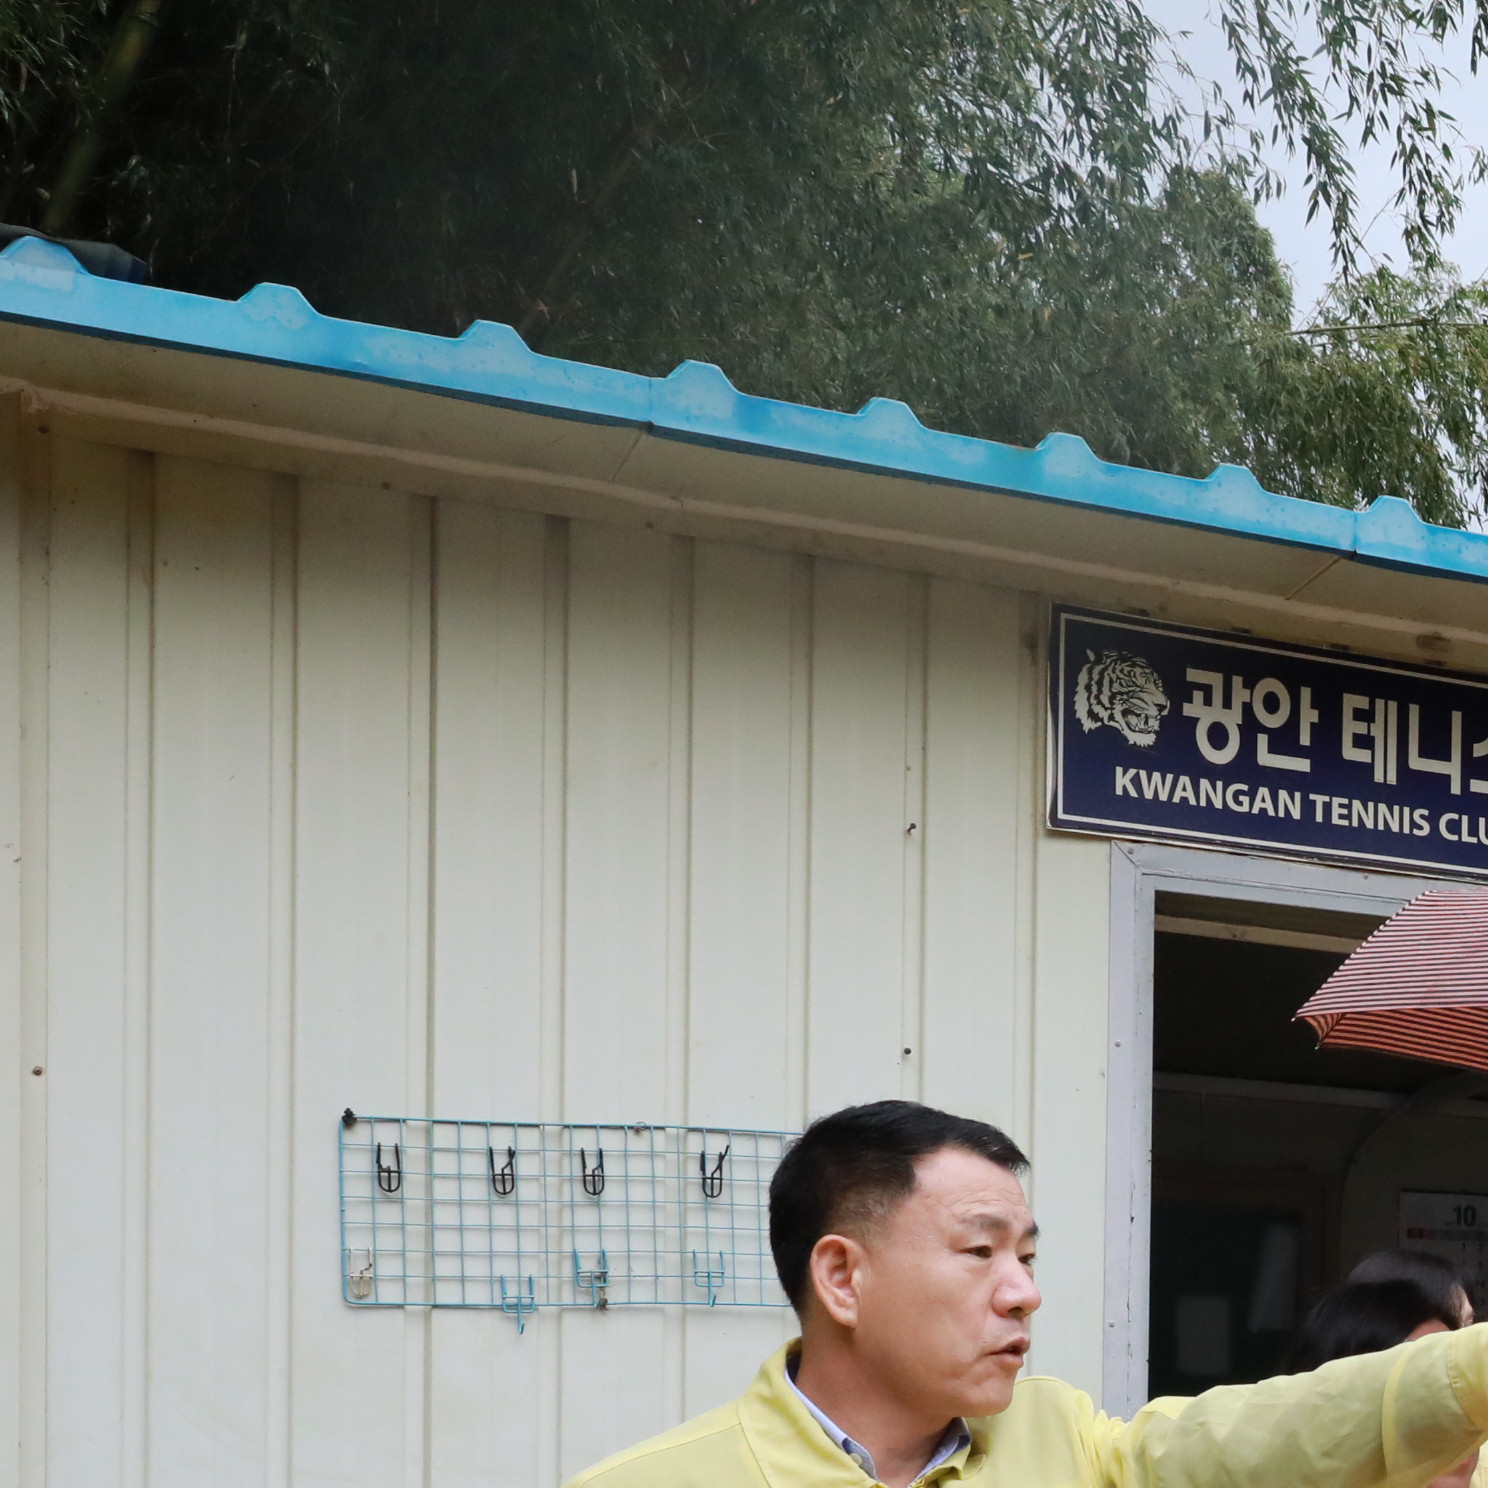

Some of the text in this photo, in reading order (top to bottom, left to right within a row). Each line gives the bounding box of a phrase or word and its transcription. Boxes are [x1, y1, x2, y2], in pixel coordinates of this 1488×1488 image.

[1182, 666, 1319, 774] 광안
[1114, 765, 1302, 821] KWANGAN
[1310, 793, 1431, 837] TENNIS
[1453, 1204, 1477, 1227] 10
